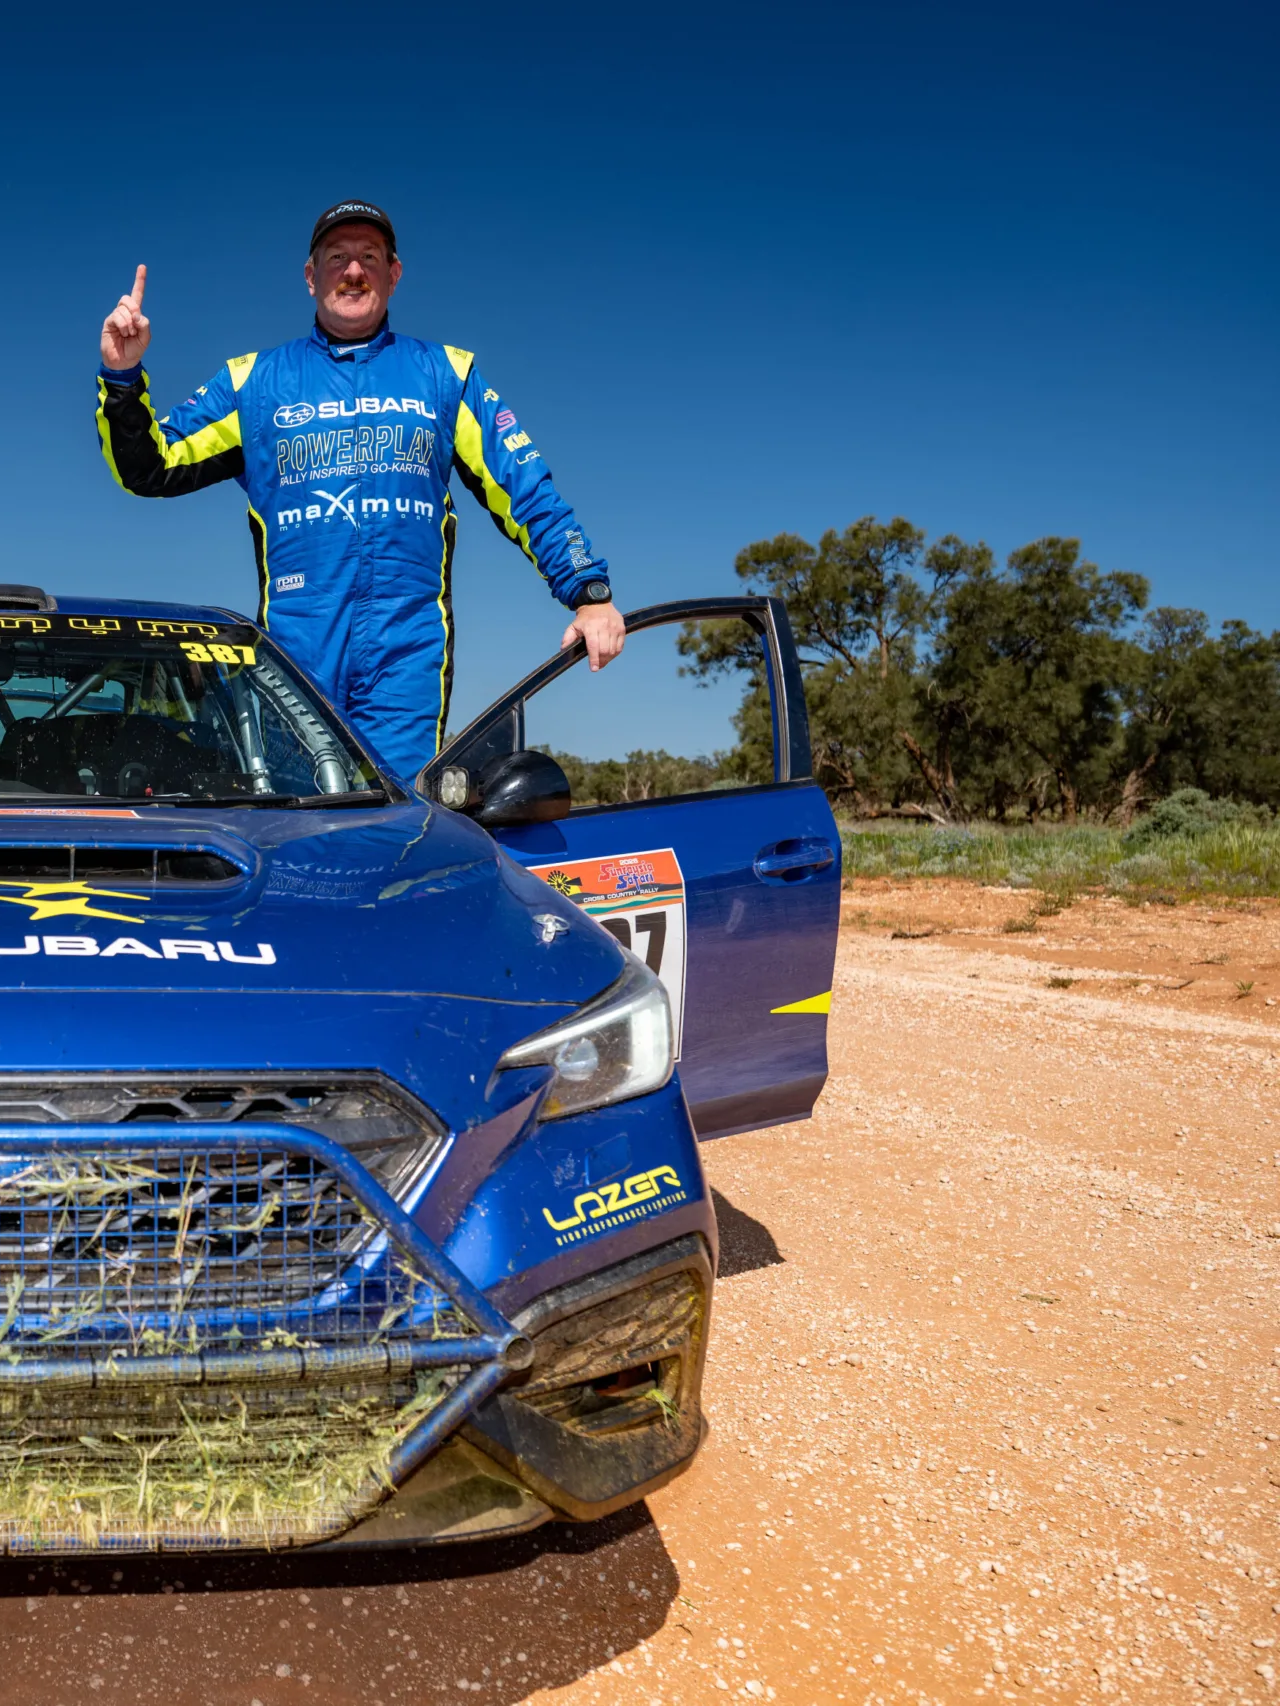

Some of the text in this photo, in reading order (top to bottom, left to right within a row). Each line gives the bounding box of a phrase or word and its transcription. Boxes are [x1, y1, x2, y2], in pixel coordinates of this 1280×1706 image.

[318, 397, 437, 420] SUBARU
[277, 425, 436, 476] POWERPLAY
[280, 463, 430, 488] RALLY INSPIRED GO-KARTING
[277, 575, 304, 588] rpm
[179, 642, 257, 665] 387
[598, 861, 655, 882] Sunraysia
[616, 871, 655, 891] Safari
[583, 895, 605, 903] CROSS
[607, 890, 637, 900] COUNTRY
[542, 1165, 681, 1231] LAZER
